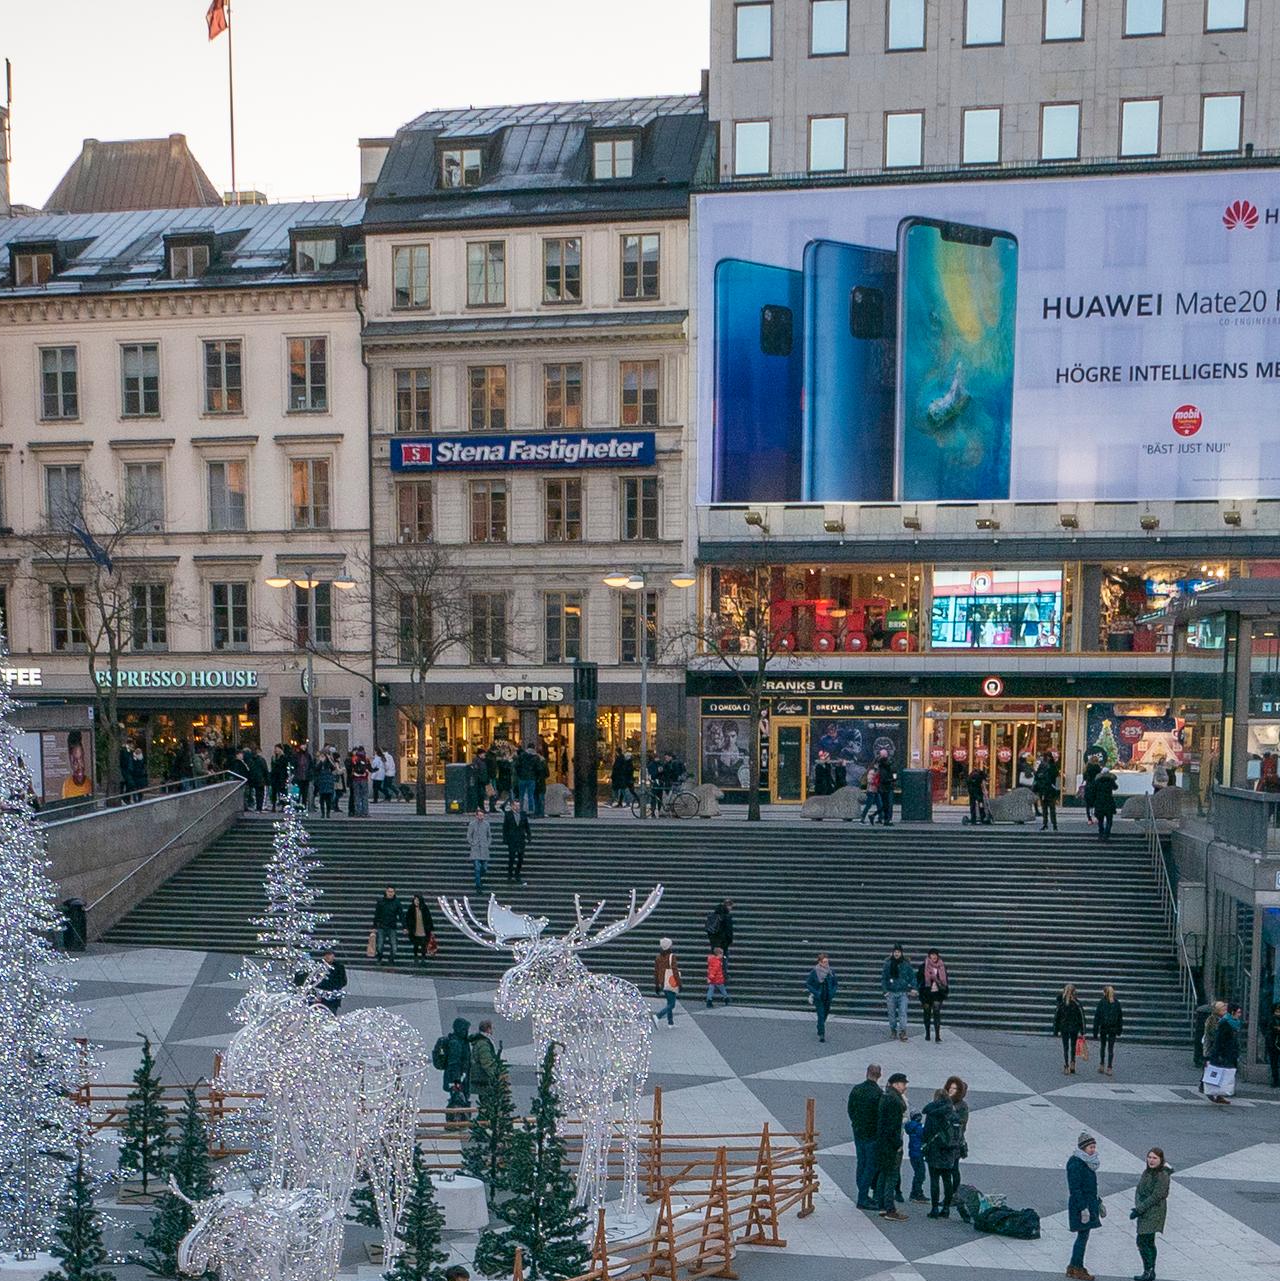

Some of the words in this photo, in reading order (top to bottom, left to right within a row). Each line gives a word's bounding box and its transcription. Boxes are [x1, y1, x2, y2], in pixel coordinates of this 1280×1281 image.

[1042, 293, 1163, 321] HUAWEI
[1175, 290, 1267, 315] Mate20
[1055, 362, 1123, 385] HÖGRE
[1129, 360, 1249, 383] INTELLIGENS
[1173, 407, 1201, 421] mobil
[436, 440, 505, 463] Stena
[508, 437, 644, 464] Fastigheter
[1177, 442, 1202, 454] JUST
[190, 669, 259, 688] HOUSE
[485, 683, 565, 703] Jerns
[717, 703, 742, 712] OMEGA
[815, 703, 855, 712] BREITLING
